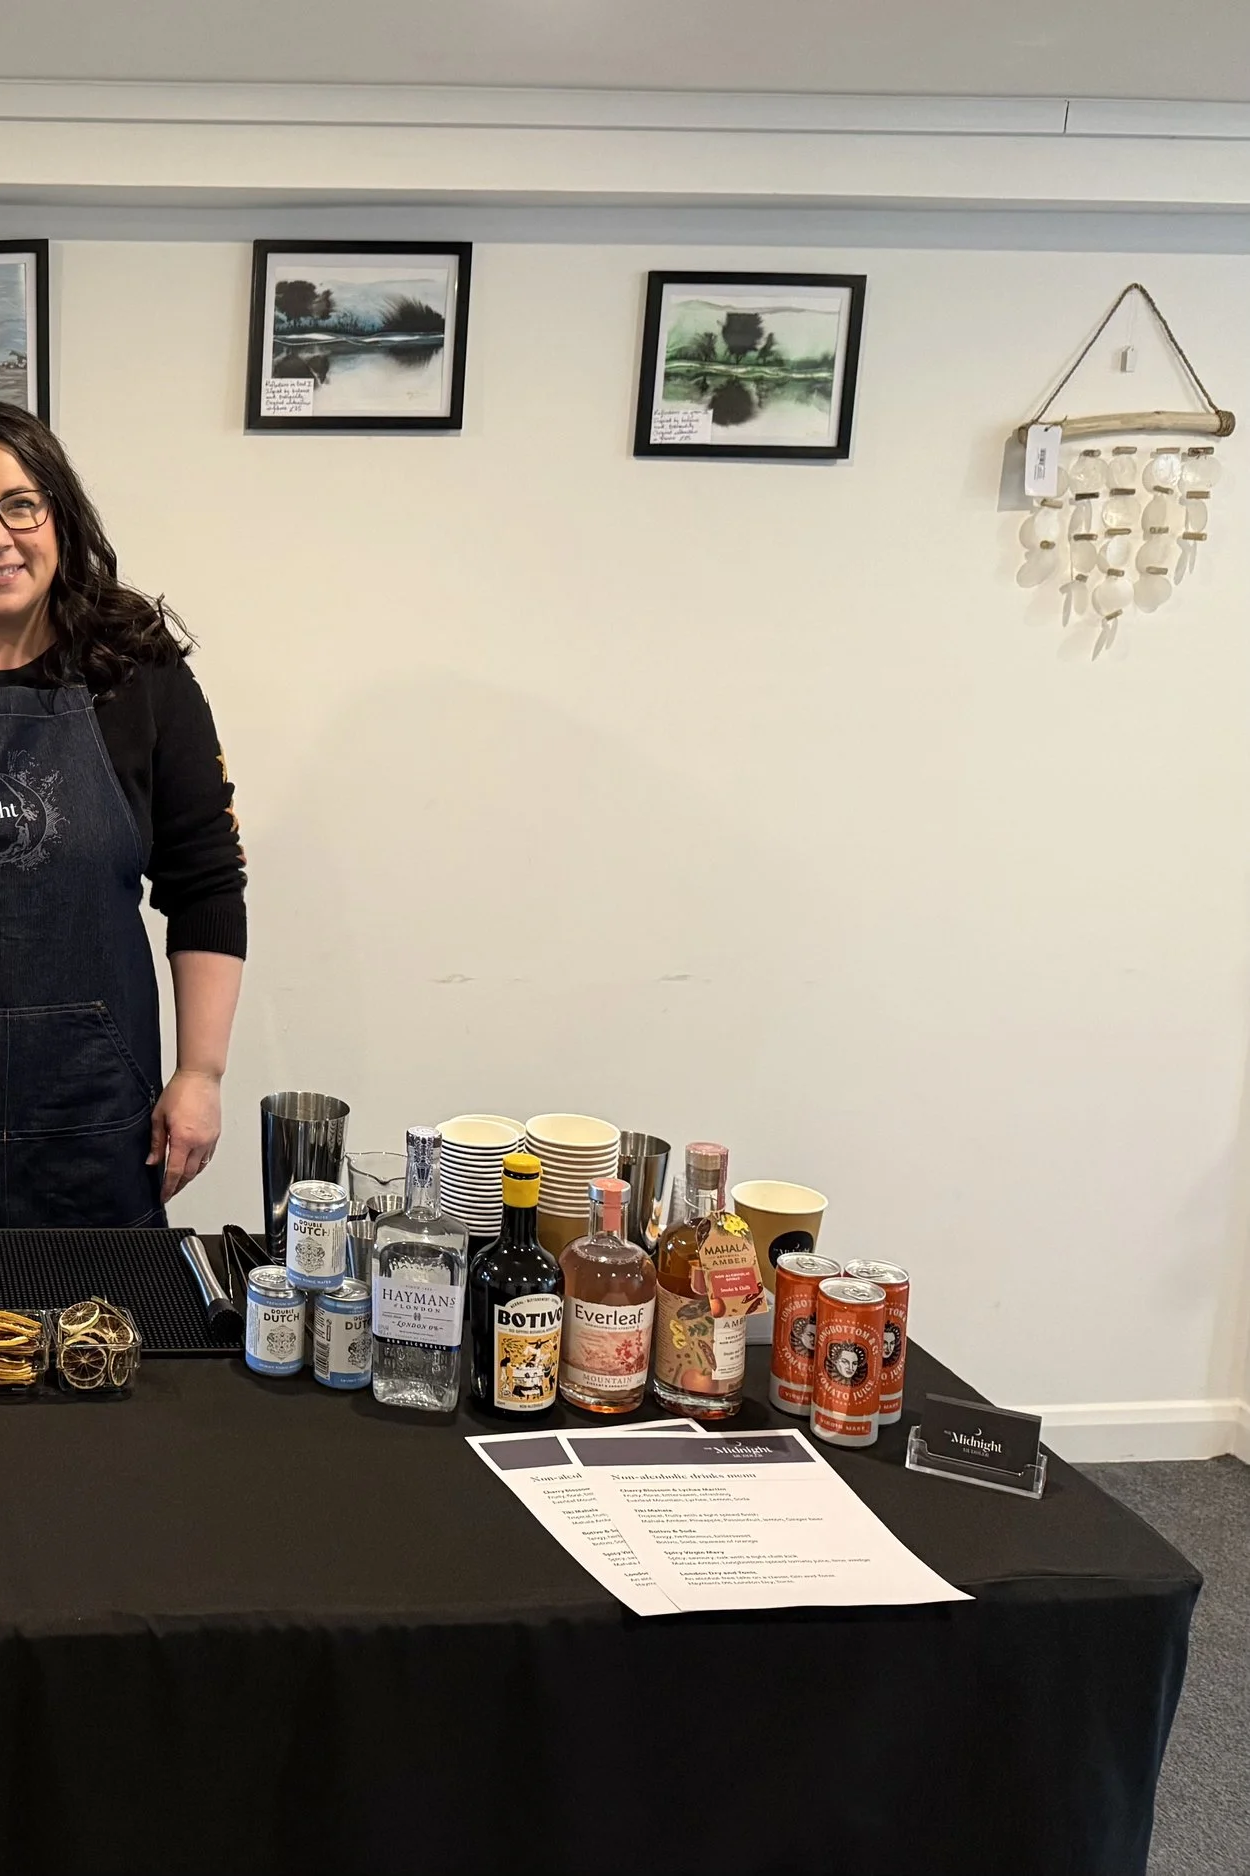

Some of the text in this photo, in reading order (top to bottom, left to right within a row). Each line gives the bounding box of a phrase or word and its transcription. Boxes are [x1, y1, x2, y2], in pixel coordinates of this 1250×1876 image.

[293, 1222, 330, 1237] DUTCH
[299, 1219, 322, 1228] DOUBLE
[705, 1243, 750, 1256] MAHALA
[712, 1257, 747, 1266] AMBER
[400, 1303, 441, 1313] LONDON
[575, 1303, 644, 1326] Everleaf
[263, 1312, 300, 1323] DUTCH
[497, 1306, 563, 1329] BOTIVO
[396, 1321, 426, 1329] LONDON
[818, 1325, 870, 1347] LONGBOTTOM
[781, 1346, 814, 1372] TOMATO
[583, 1372, 632, 1385] MOUNTAIN
[818, 1372, 874, 1401] TOMATO JUICE
[820, 1417, 843, 1430] VIRGIN
[951, 1431, 1002, 1453] Midnight
[713, 1445, 773, 1455] Midnight
